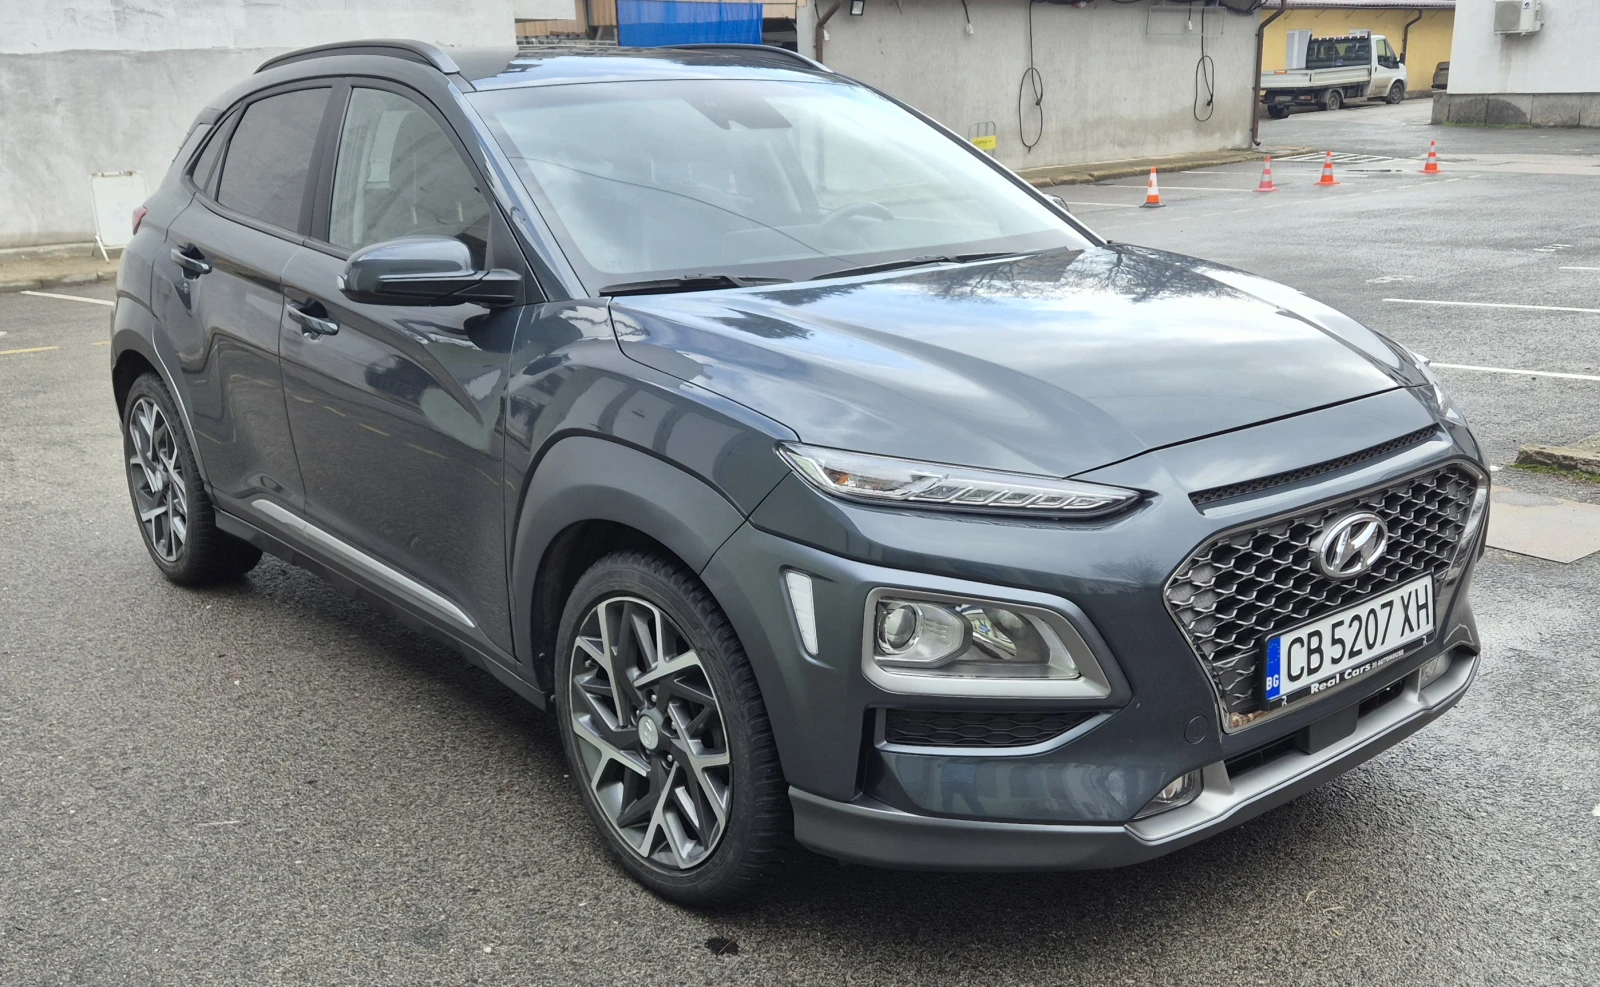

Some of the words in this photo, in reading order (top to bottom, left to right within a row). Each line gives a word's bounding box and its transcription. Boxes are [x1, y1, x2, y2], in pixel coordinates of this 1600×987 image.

[1287, 629, 1324, 682] CB
[1331, 599, 1394, 665] 5207
[1400, 584, 1430, 638] XH
[1266, 674, 1280, 691] BG
[1310, 674, 1340, 694] Real
[1344, 663, 1371, 680] Cars
